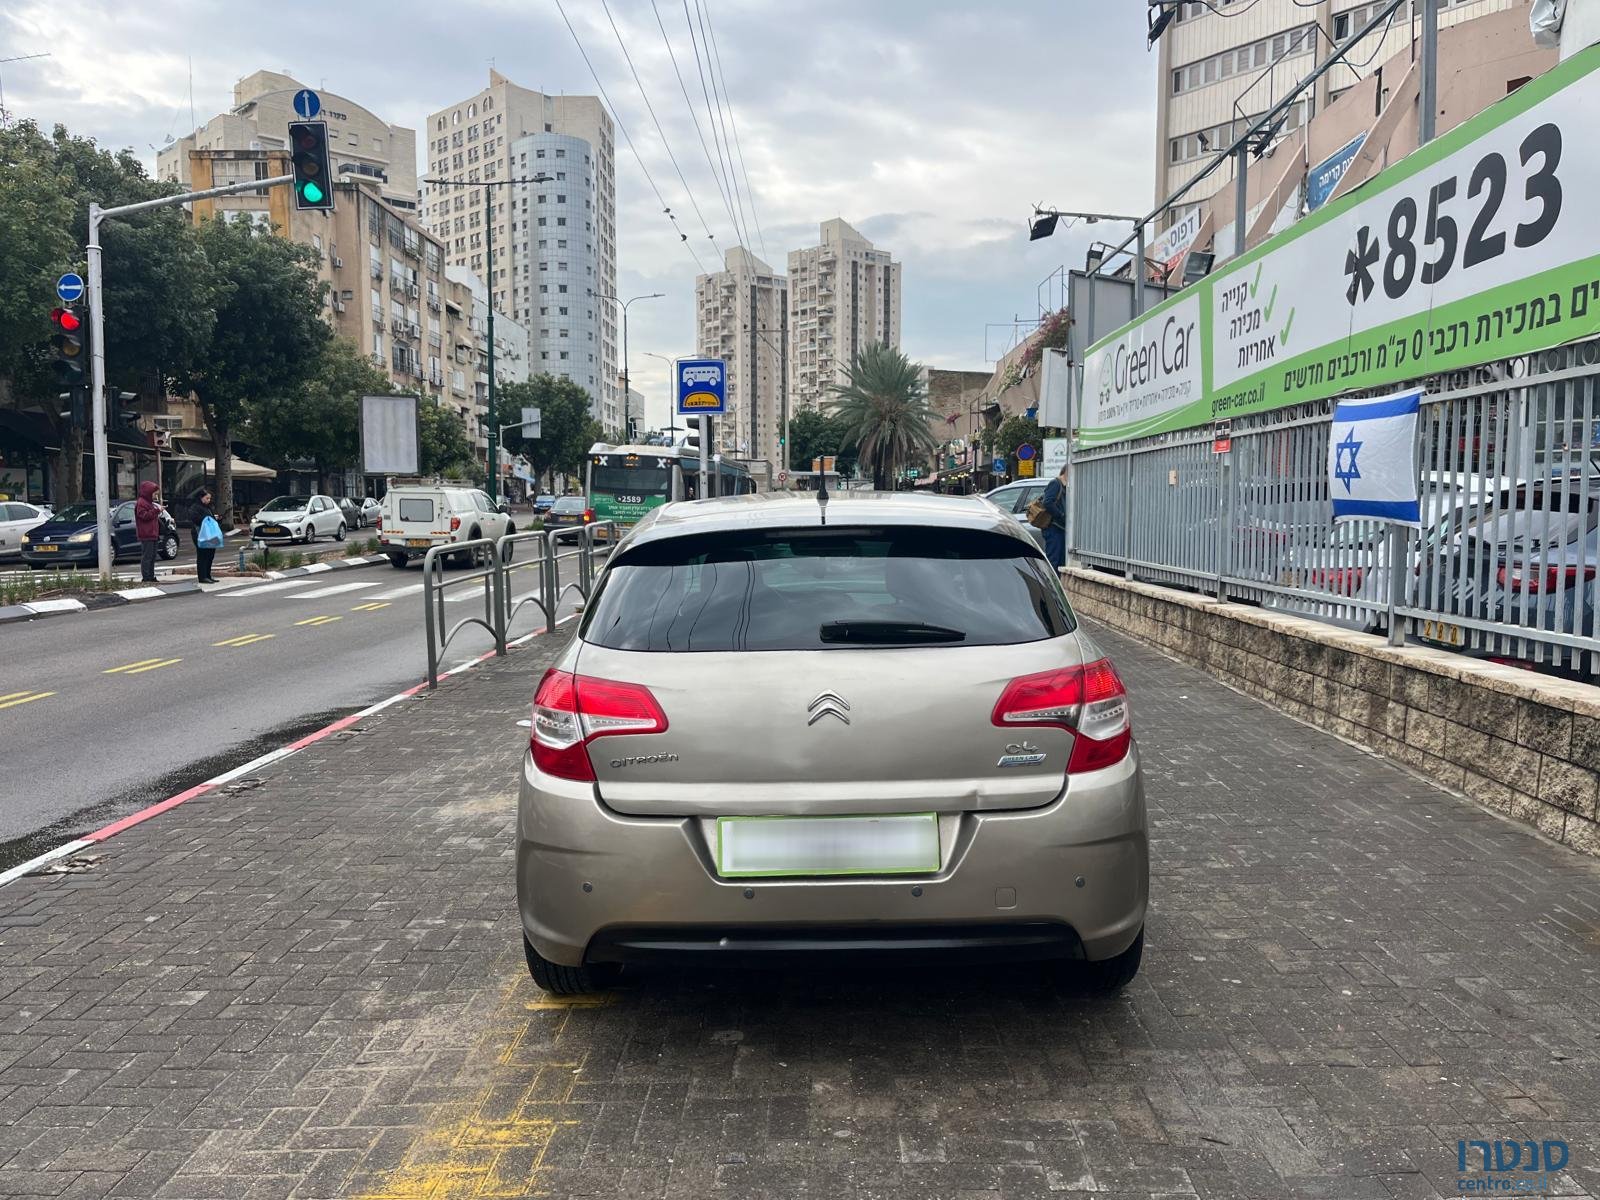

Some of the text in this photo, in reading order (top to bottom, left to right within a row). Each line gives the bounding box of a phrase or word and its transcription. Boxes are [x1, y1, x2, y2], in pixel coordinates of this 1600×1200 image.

[1170, 216, 1194, 248] דפוס
[1221, 282, 1248, 312] קנייה
[1571, 280, 1600, 319] ים
[1229, 308, 1261, 340] מכירה
[1475, 293, 1562, 344] במכירת
[1114, 315, 1195, 394] Green Car
[1237, 335, 1276, 368] אחריות
[1428, 321, 1469, 355] רכבי
[1283, 362, 1324, 392] חדשים
[1327, 348, 1372, 382] ורכבים
[1211, 381, 1266, 417] green-car.co.il
[609, 751, 679, 768] CITROËN
[1005, 740, 1039, 754] C4
